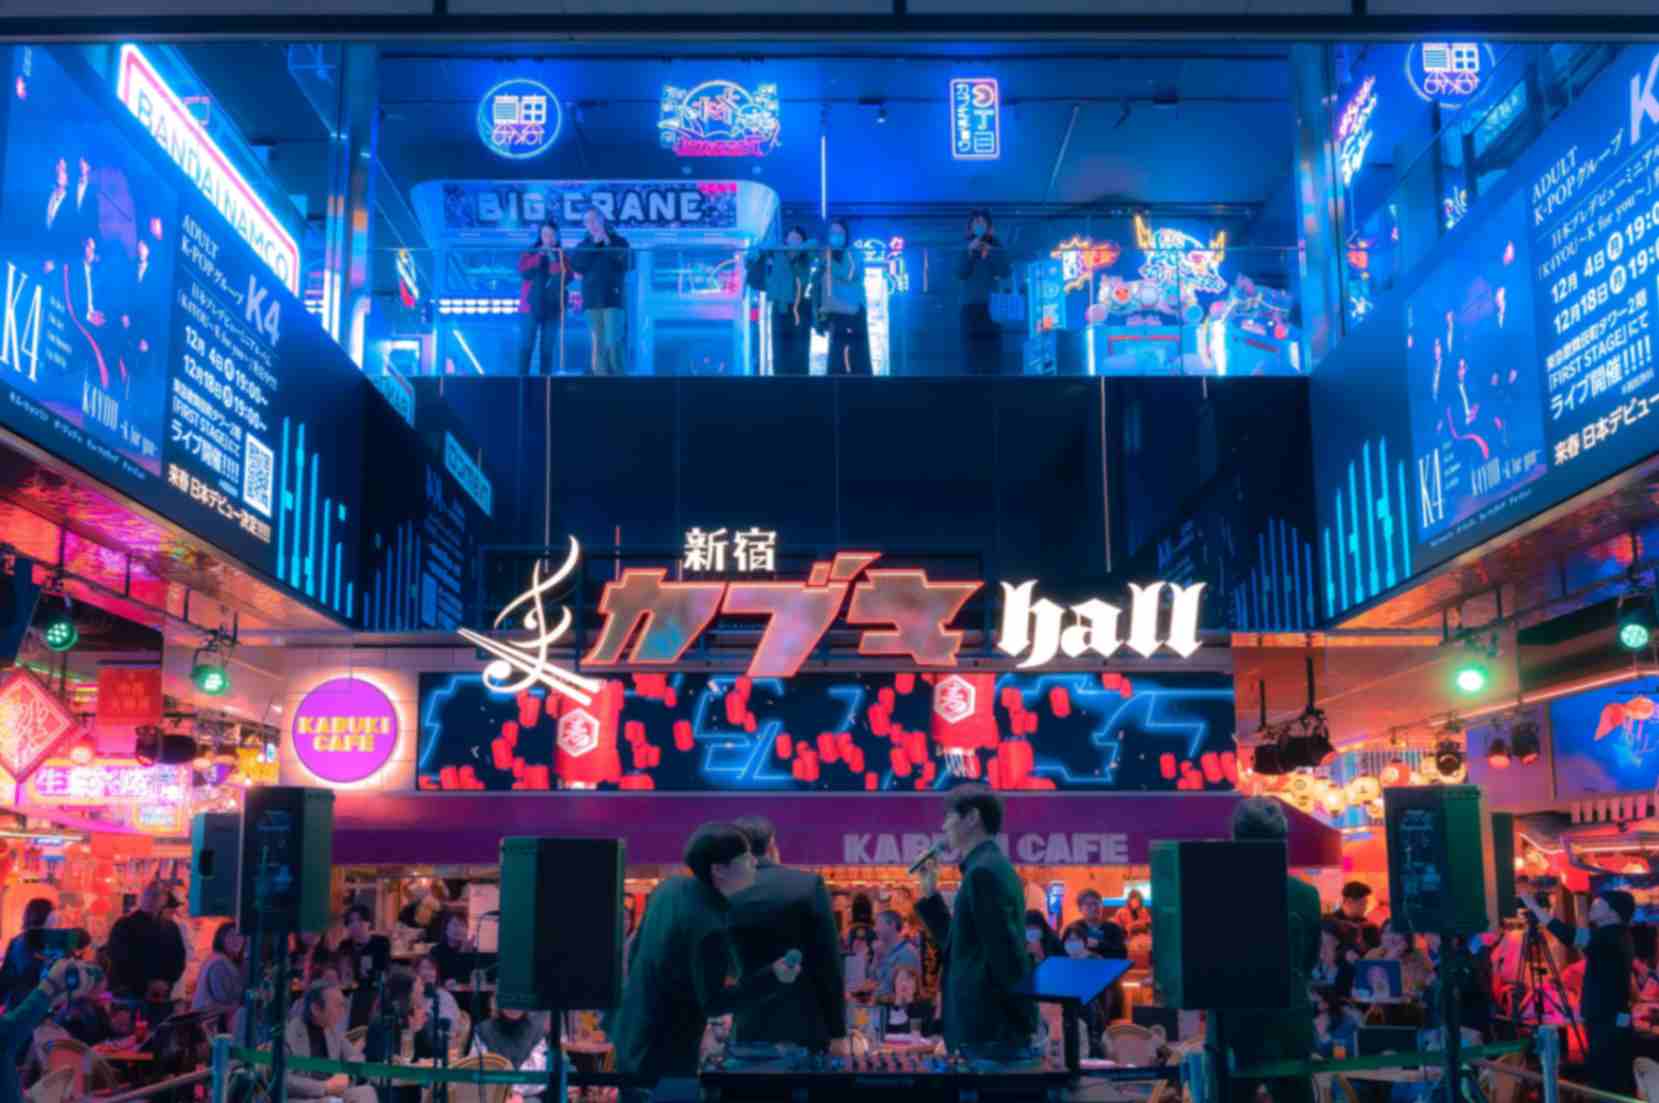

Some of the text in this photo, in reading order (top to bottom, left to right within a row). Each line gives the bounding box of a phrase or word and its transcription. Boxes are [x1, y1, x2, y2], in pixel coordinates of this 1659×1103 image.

[479, 191, 703, 222] BIG CRANE
[0, 261, 43, 383] K4
[245, 272, 280, 347] K4
[1418, 447, 1445, 529] K4
[684, 527, 778, 573] 新宿
[580, 551, 1208, 678] カブキ hall
[297, 715, 392, 735] KABUKI
[312, 734, 376, 753] CAFE
[1017, 832, 1129, 865] CAFE
